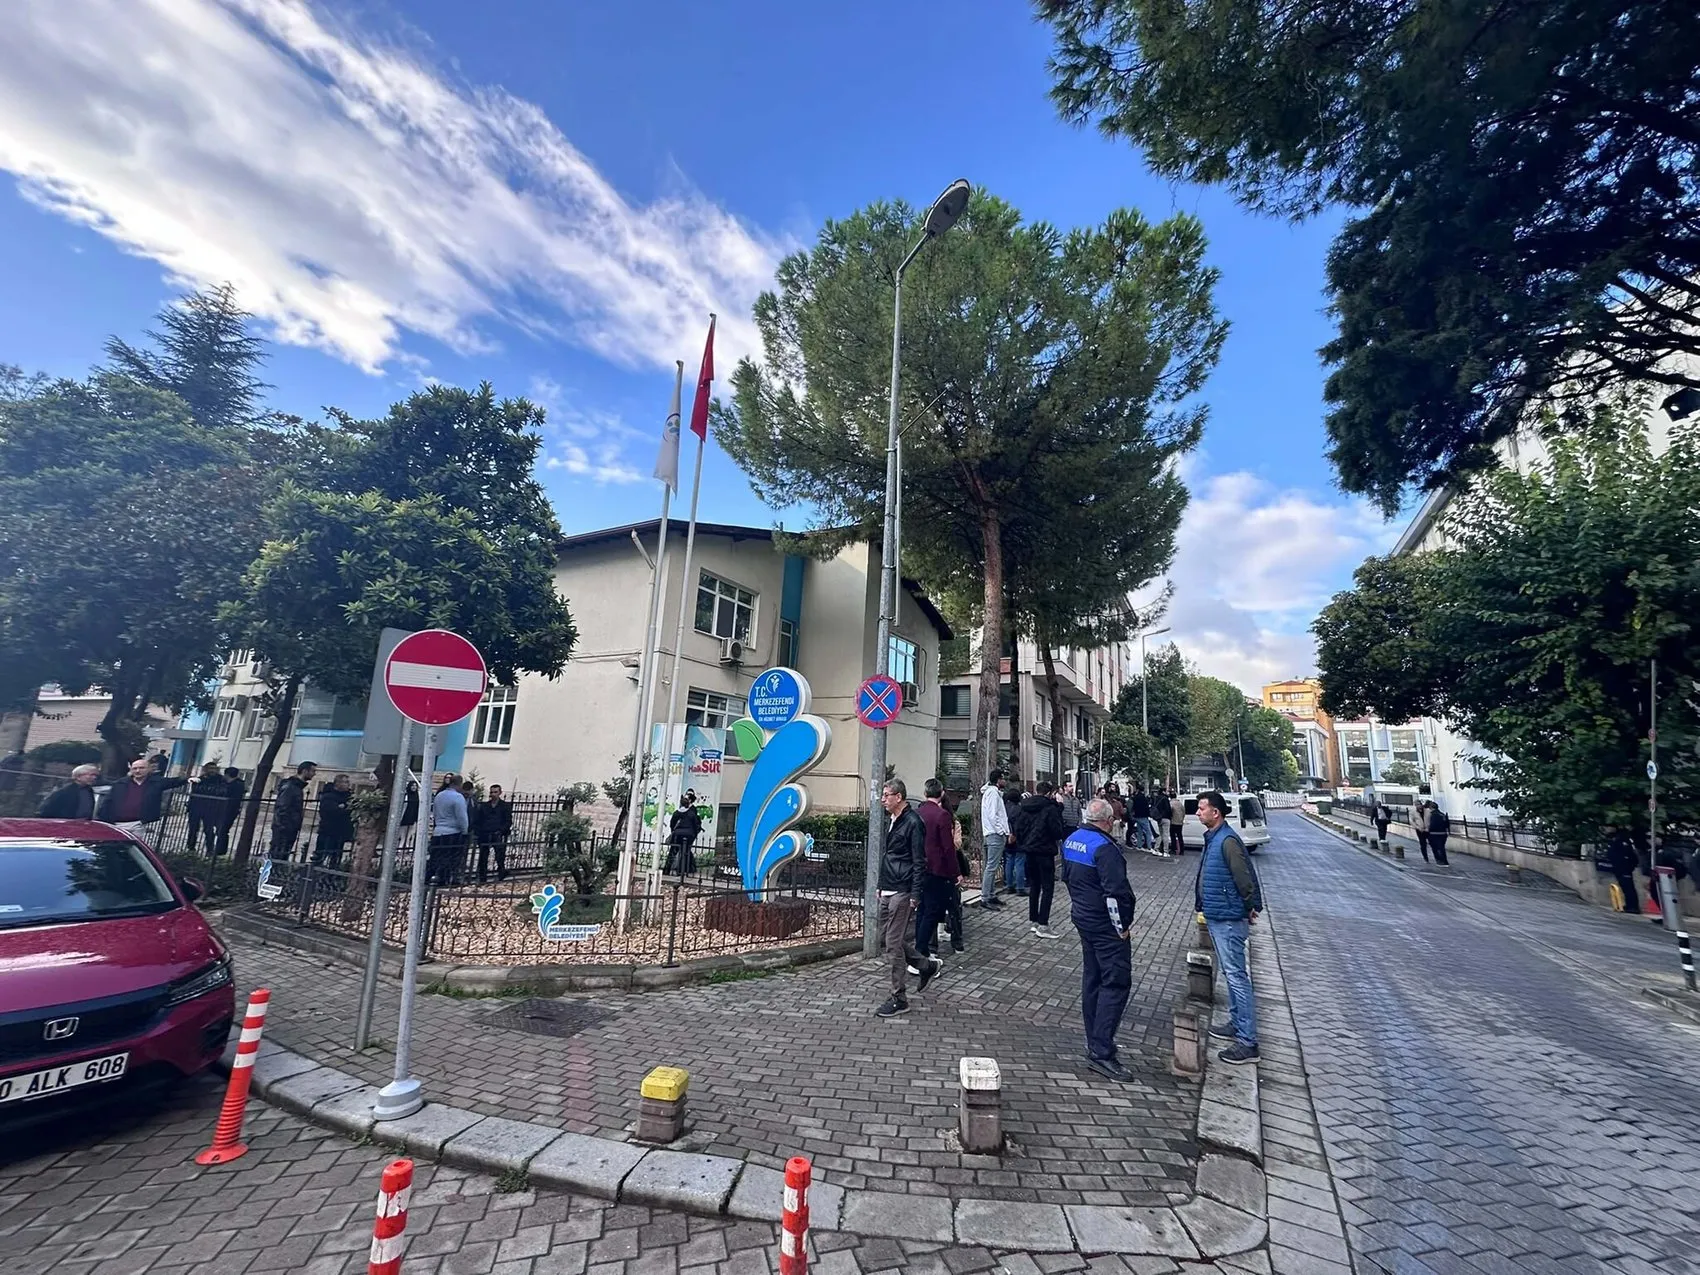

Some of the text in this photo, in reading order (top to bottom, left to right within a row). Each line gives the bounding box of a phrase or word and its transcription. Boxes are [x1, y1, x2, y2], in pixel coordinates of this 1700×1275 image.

[755, 686, 768, 697] T.C.
[26, 1067, 72, 1094] ALK
[84, 1055, 125, 1081] 608
